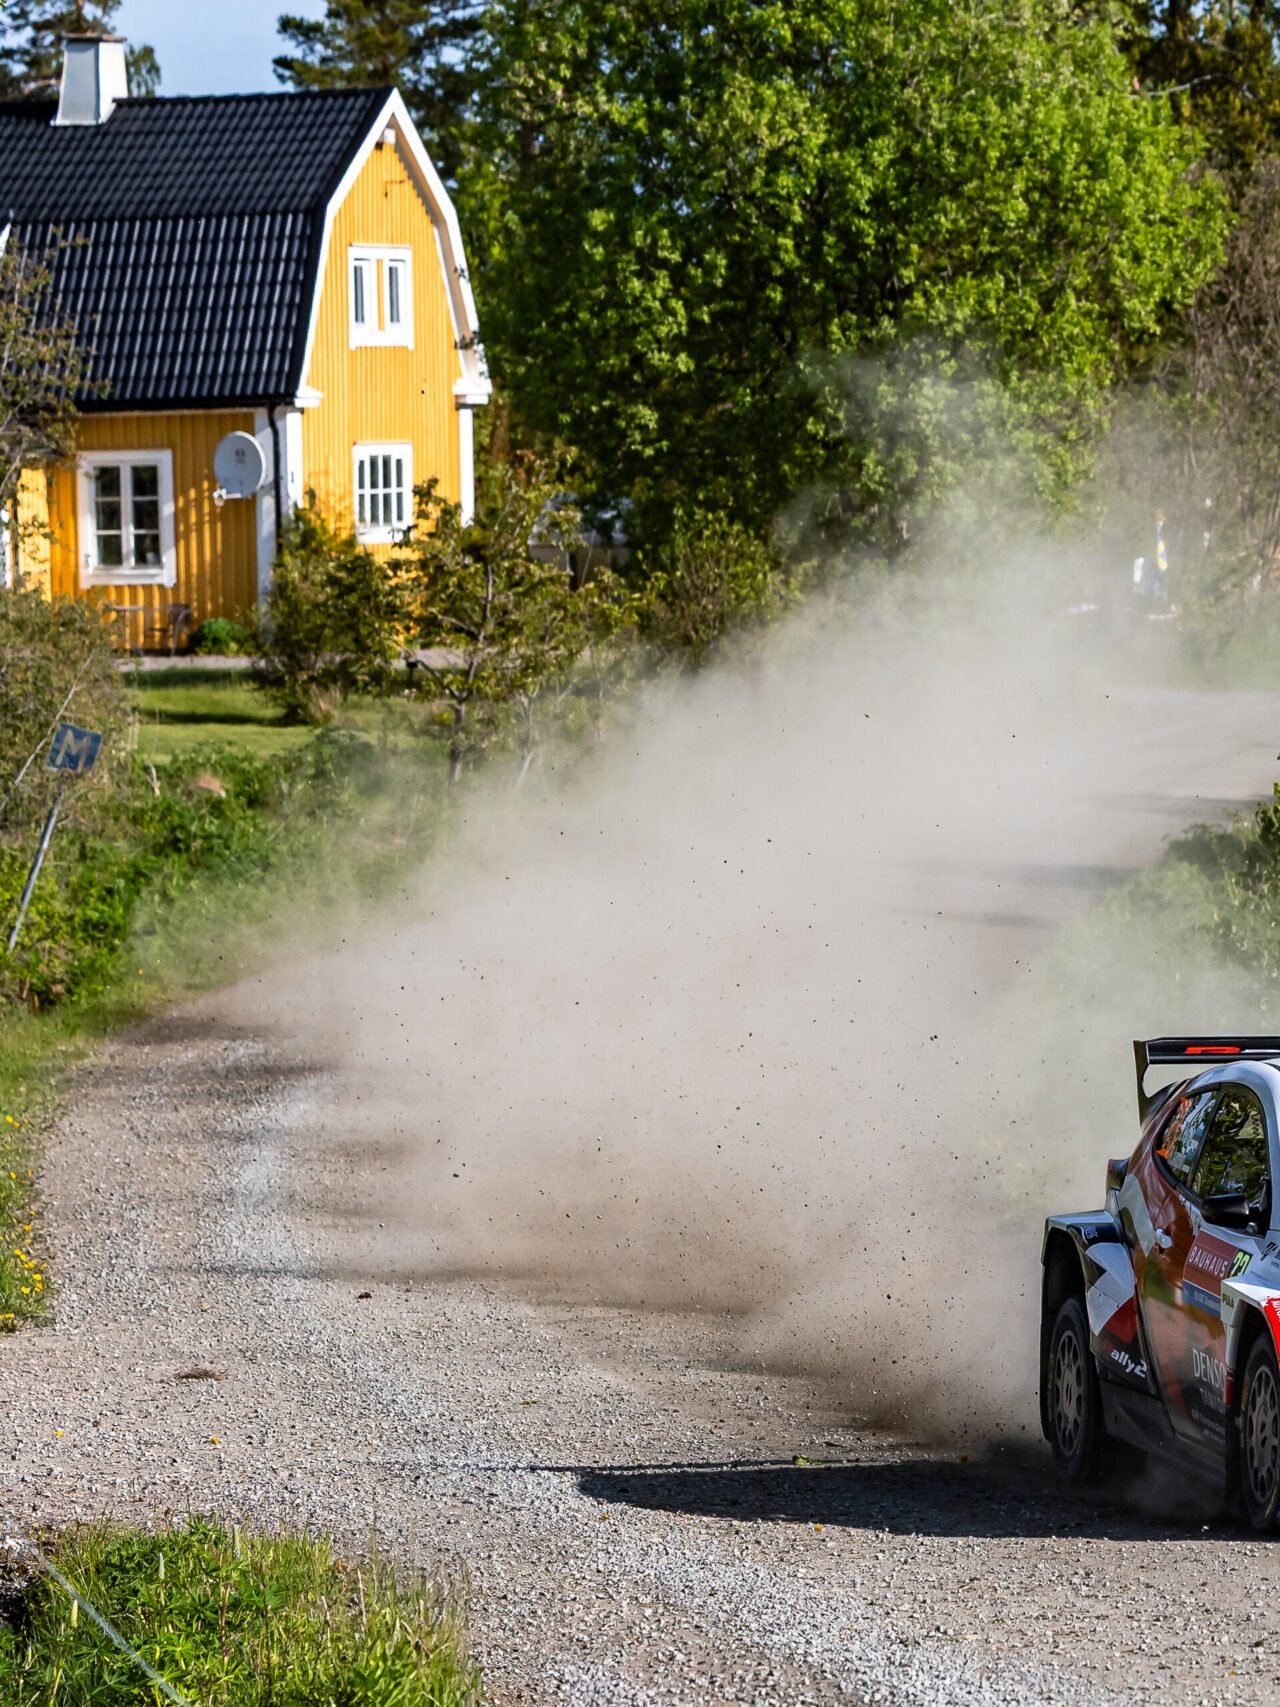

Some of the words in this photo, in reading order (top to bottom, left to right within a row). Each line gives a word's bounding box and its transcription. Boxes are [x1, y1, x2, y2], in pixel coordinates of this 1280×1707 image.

[56, 729, 90, 773] M
[1189, 1246, 1228, 1278] BAUHAUS
[1192, 1347, 1226, 1392] DENSO
